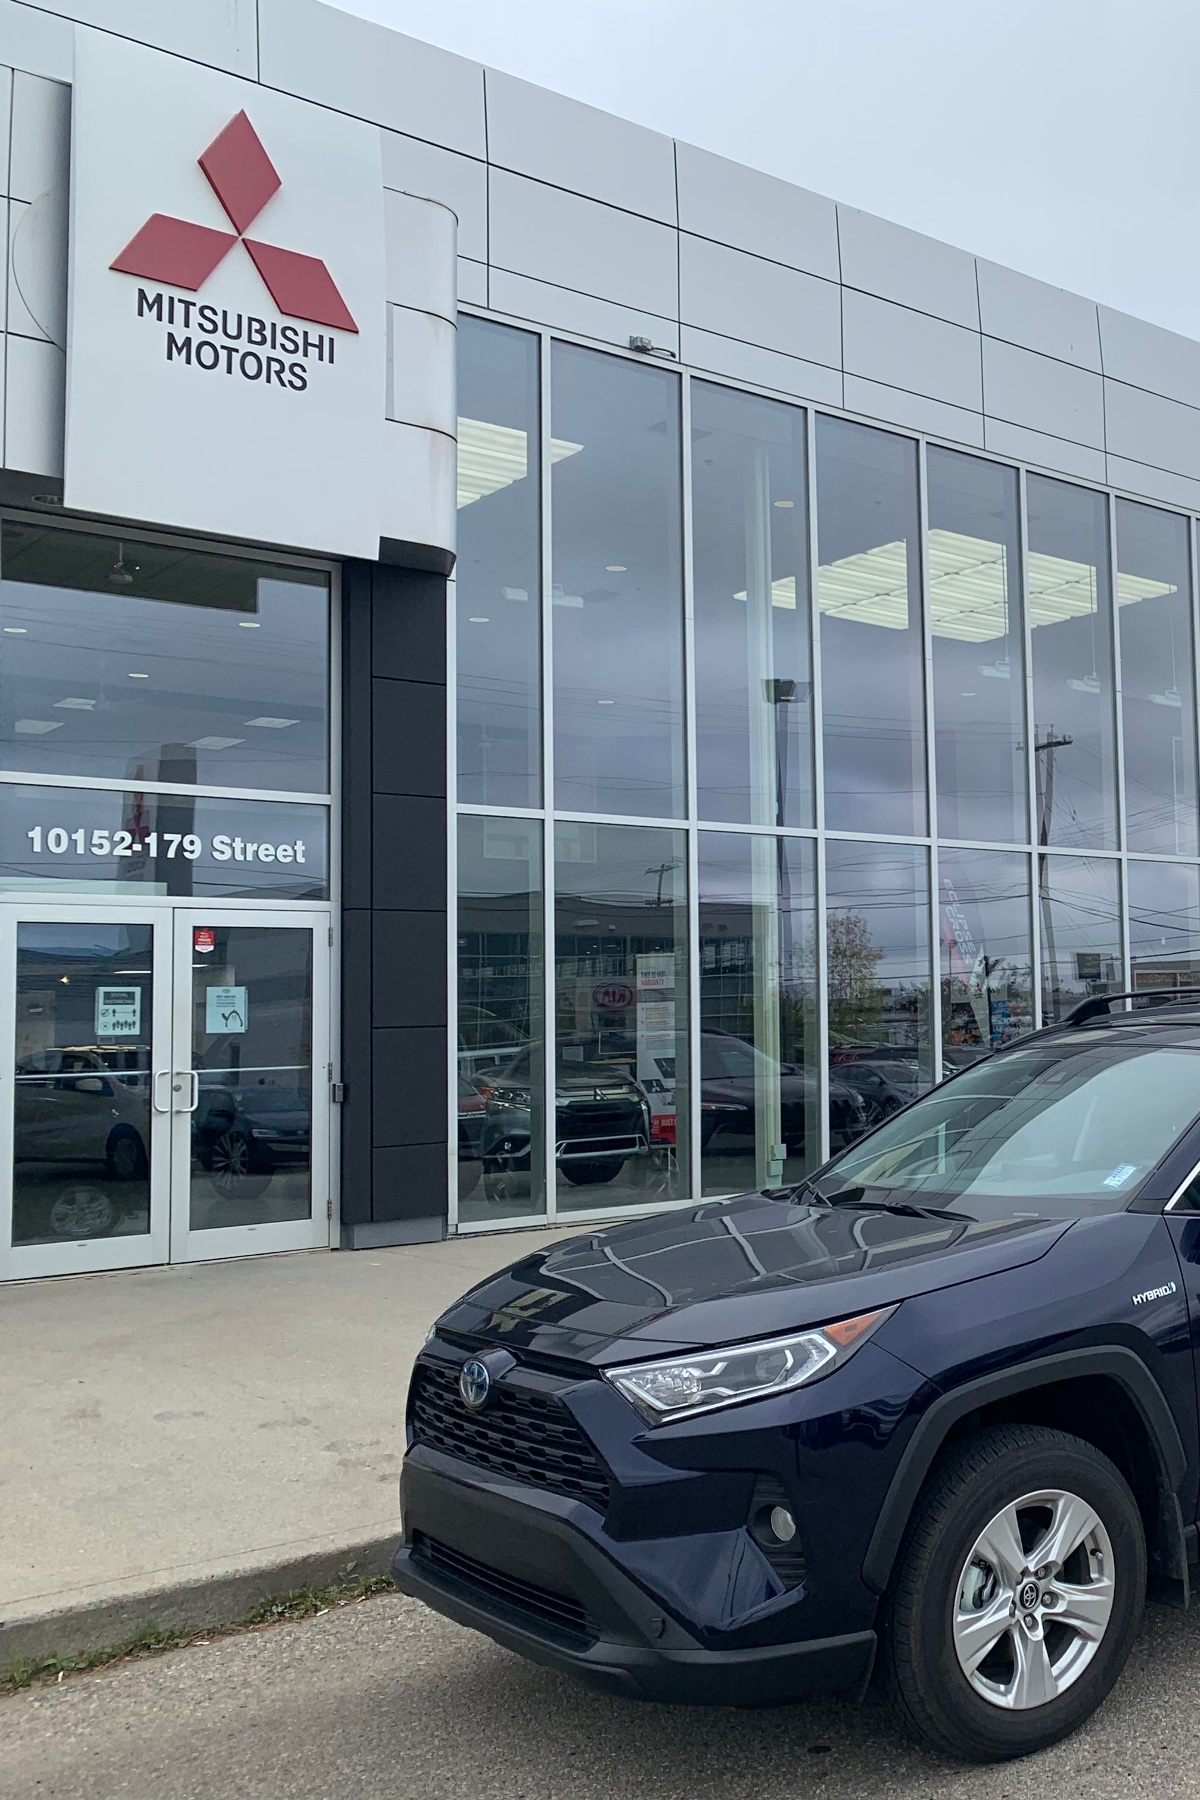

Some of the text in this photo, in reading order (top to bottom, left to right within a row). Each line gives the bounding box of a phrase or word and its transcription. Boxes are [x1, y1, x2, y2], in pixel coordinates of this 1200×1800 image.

[137, 288, 335, 364] MITSUBISHI
[166, 331, 308, 391] MOTORS
[27, 826, 306, 863] 10152-179 Street
[943, 878, 977, 952] ECLIPSE
[945, 905, 973, 965] CROSS
[1132, 1284, 1171, 1306] HYBRID
